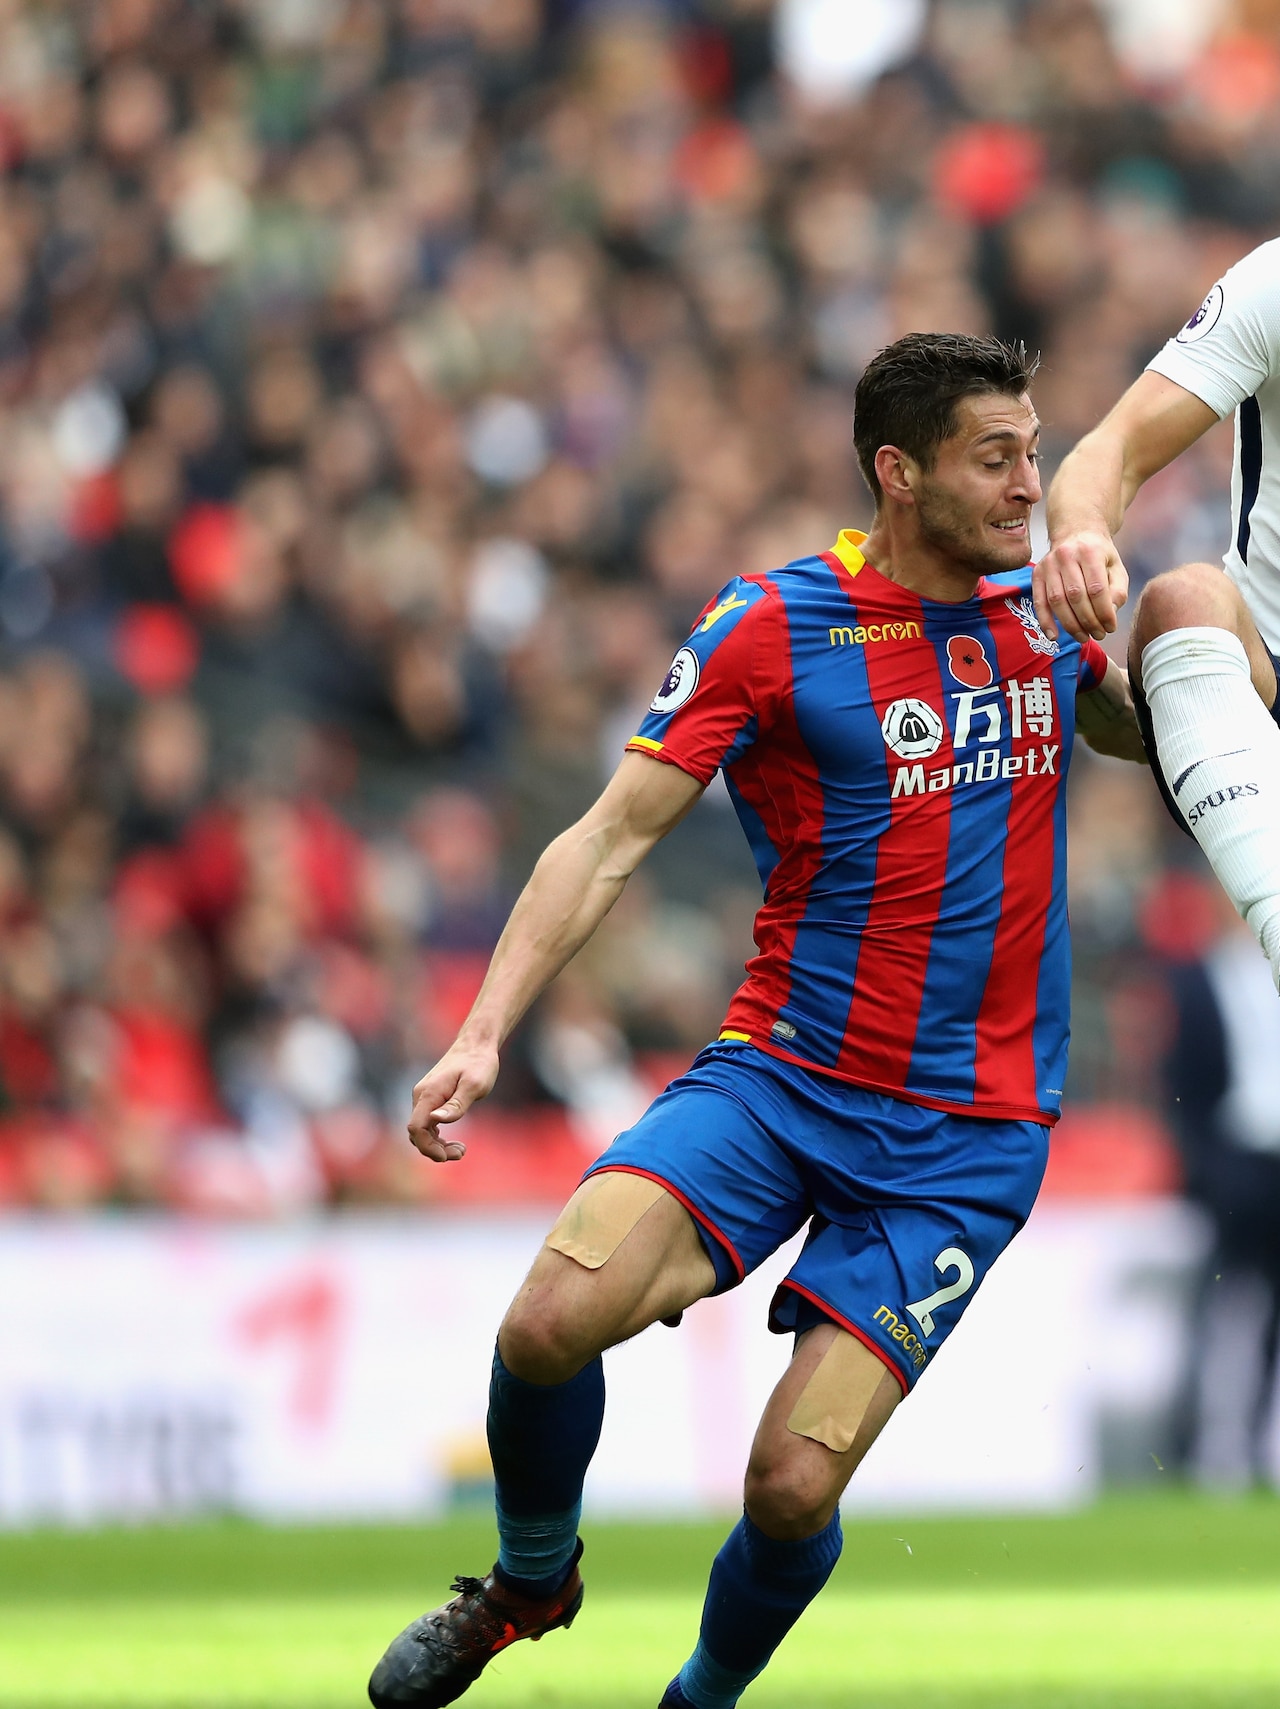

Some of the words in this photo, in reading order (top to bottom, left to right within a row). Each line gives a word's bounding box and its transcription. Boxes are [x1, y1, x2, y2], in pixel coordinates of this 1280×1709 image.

[829, 621, 921, 646] macron
[950, 676, 1054, 749] 万博
[890, 744, 1060, 799] ManBetX
[1188, 782, 1259, 826] SPURS
[905, 1246, 975, 1338] 2
